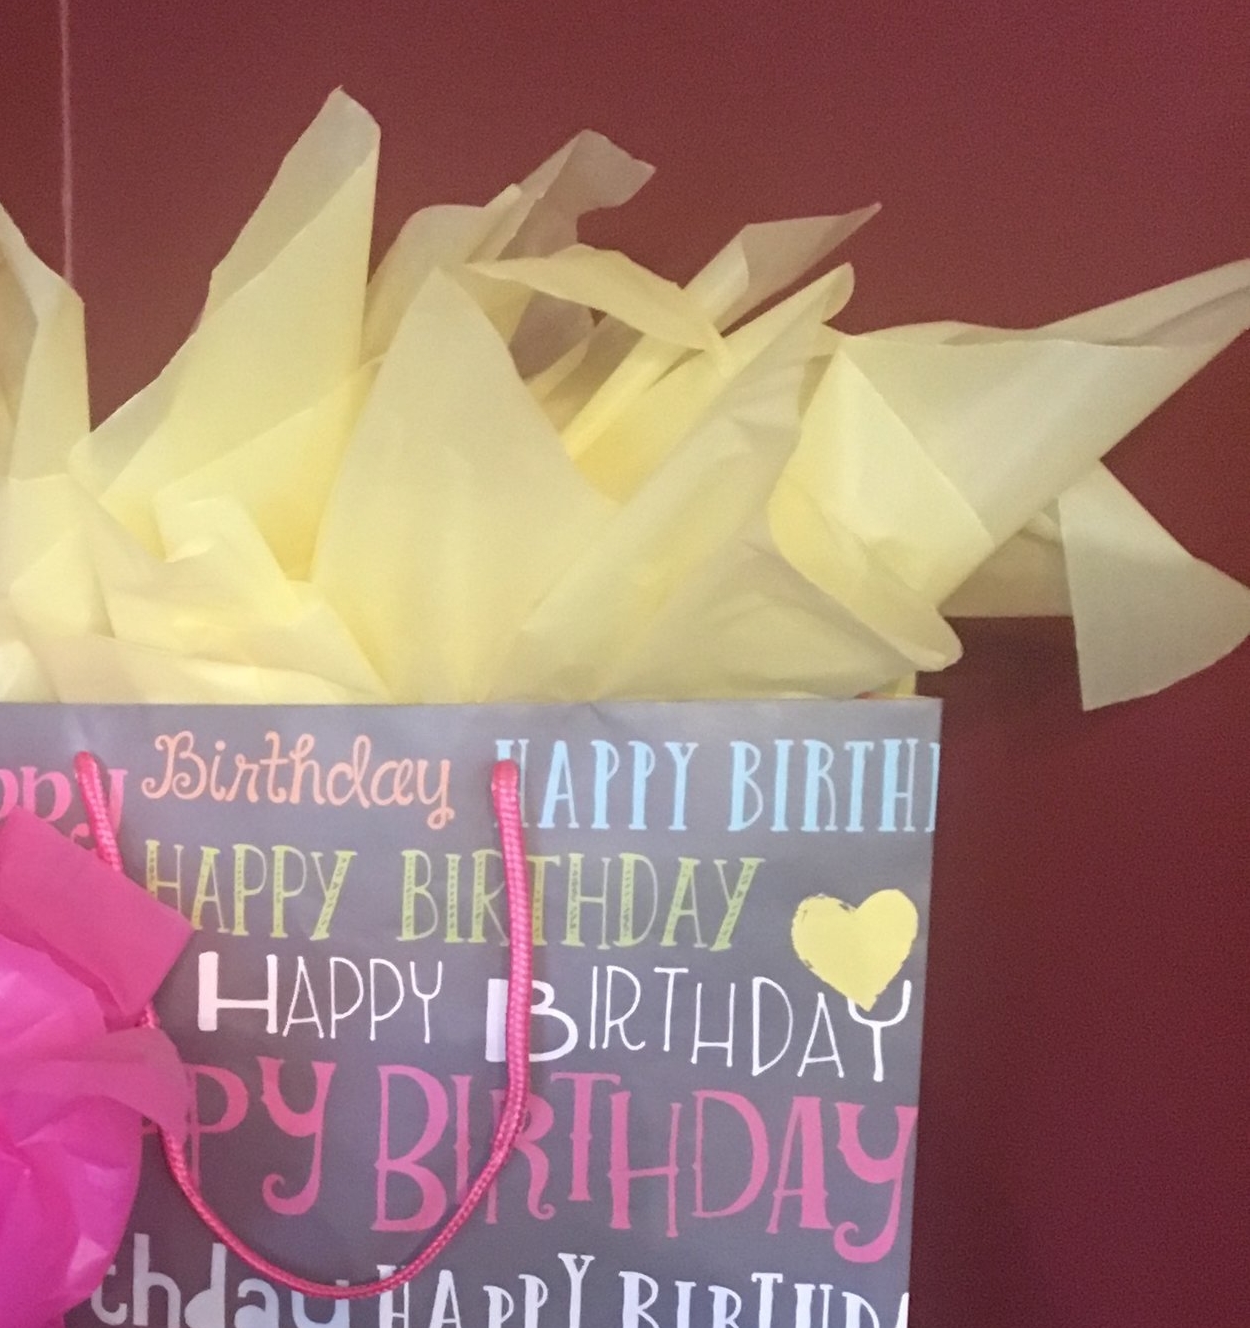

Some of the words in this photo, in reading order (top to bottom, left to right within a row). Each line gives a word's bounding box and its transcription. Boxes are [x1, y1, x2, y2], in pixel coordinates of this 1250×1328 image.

[141, 731, 454, 829] Birthday
[494, 739, 699, 831] HAPPY
[145, 839, 357, 940] HAPPY
[396, 849, 766, 952] BIRTHDAY
[197, 951, 444, 1044] HAPPY
[485, 965, 912, 1082] BIRTHDAY
[370, 1063, 918, 1264] BIRTHDAY
